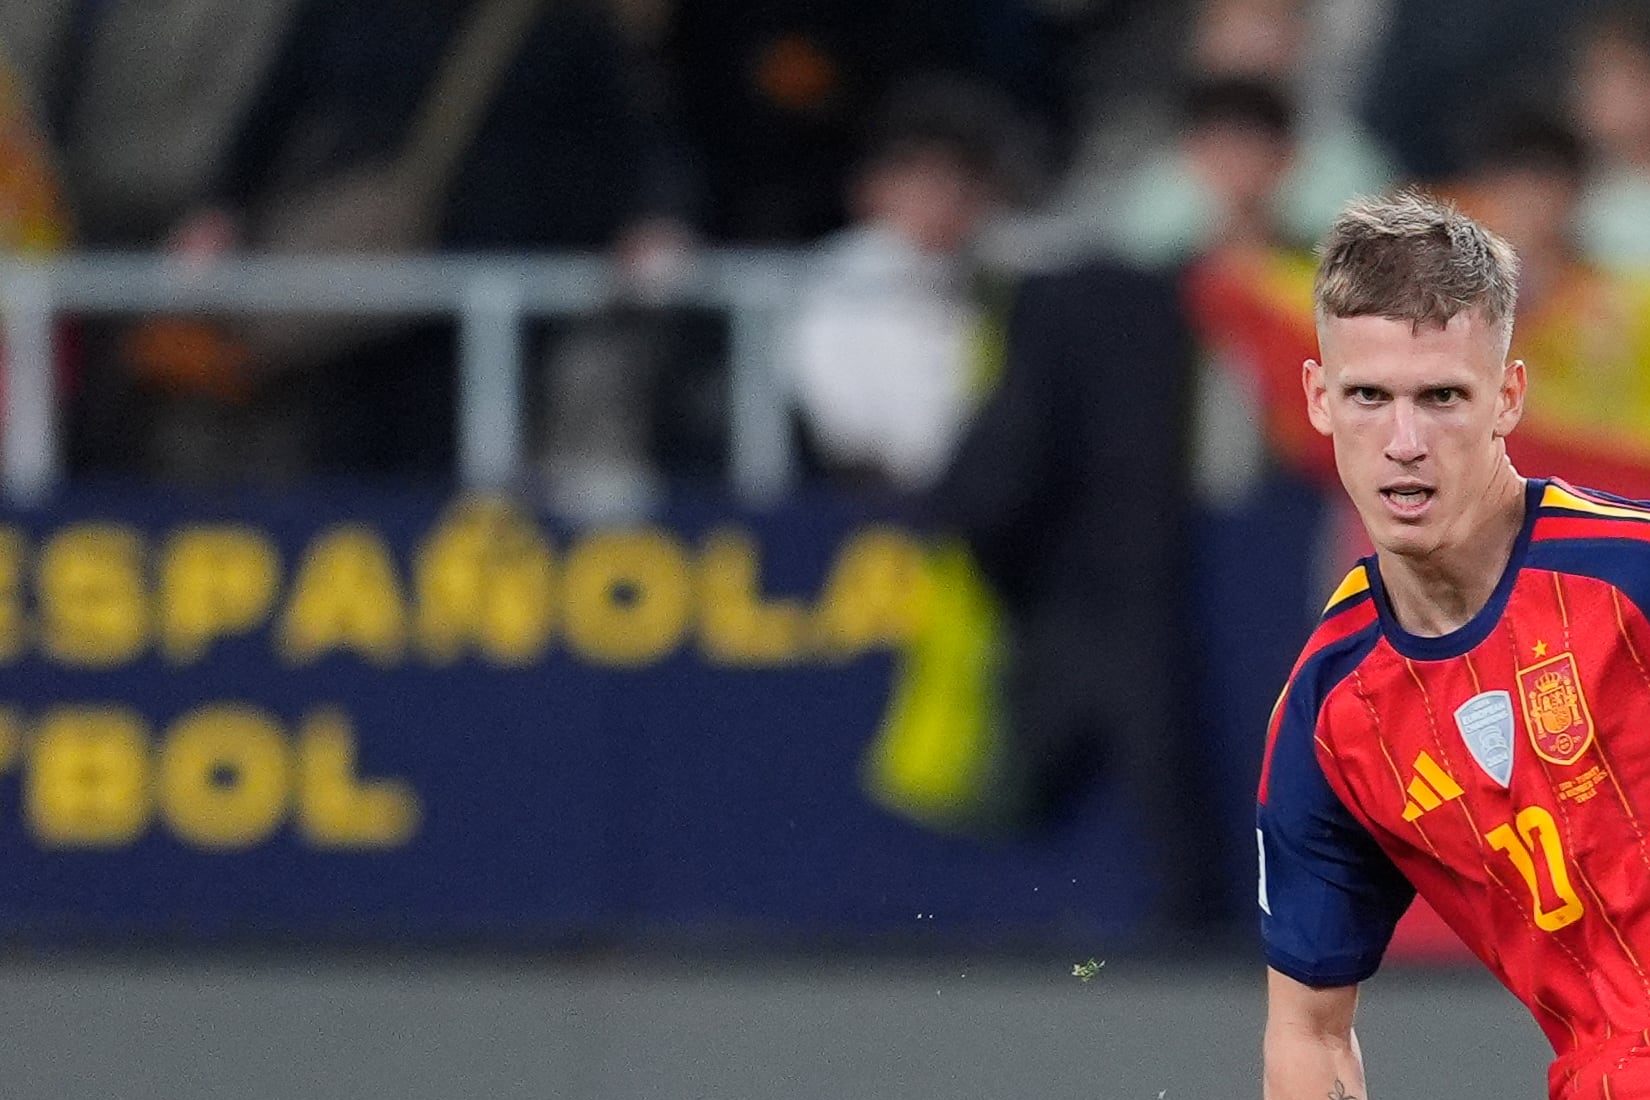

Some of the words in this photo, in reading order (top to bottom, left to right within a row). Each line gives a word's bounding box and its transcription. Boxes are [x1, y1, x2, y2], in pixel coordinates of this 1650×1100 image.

[0, 494, 930, 668] SPAÑOLA
[0, 706, 420, 850] BOL
[1484, 805, 1585, 932] 10
